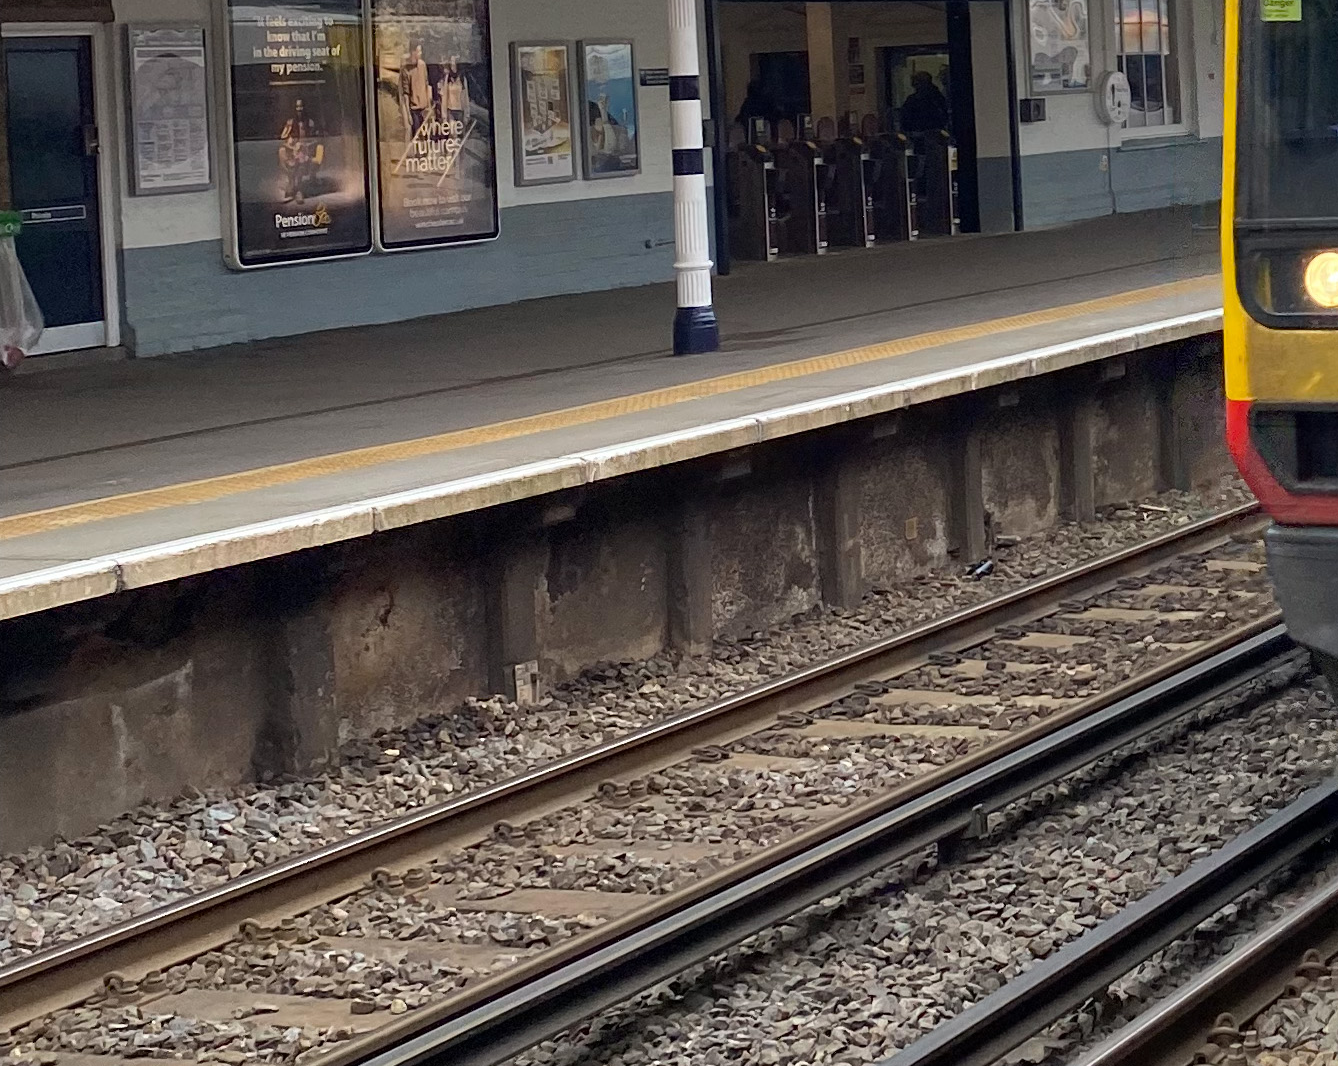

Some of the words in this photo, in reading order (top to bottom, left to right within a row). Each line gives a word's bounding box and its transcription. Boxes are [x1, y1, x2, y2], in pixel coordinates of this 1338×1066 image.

[265, 15, 286, 27] feels
[324, 17, 334, 26] to
[266, 30, 290, 42] know
[291, 30, 310, 42] that
[253, 46, 262, 57] in
[263, 46, 278, 57] the
[279, 46, 311, 59] driving
[312, 46, 329, 57] seat
[330, 44, 341, 56] of
[271, 64, 285, 75] my
[420, 118, 464, 136] where
[412, 137, 462, 155] futures
[405, 155, 454, 173] matter
[275, 212, 314, 229] Pension
